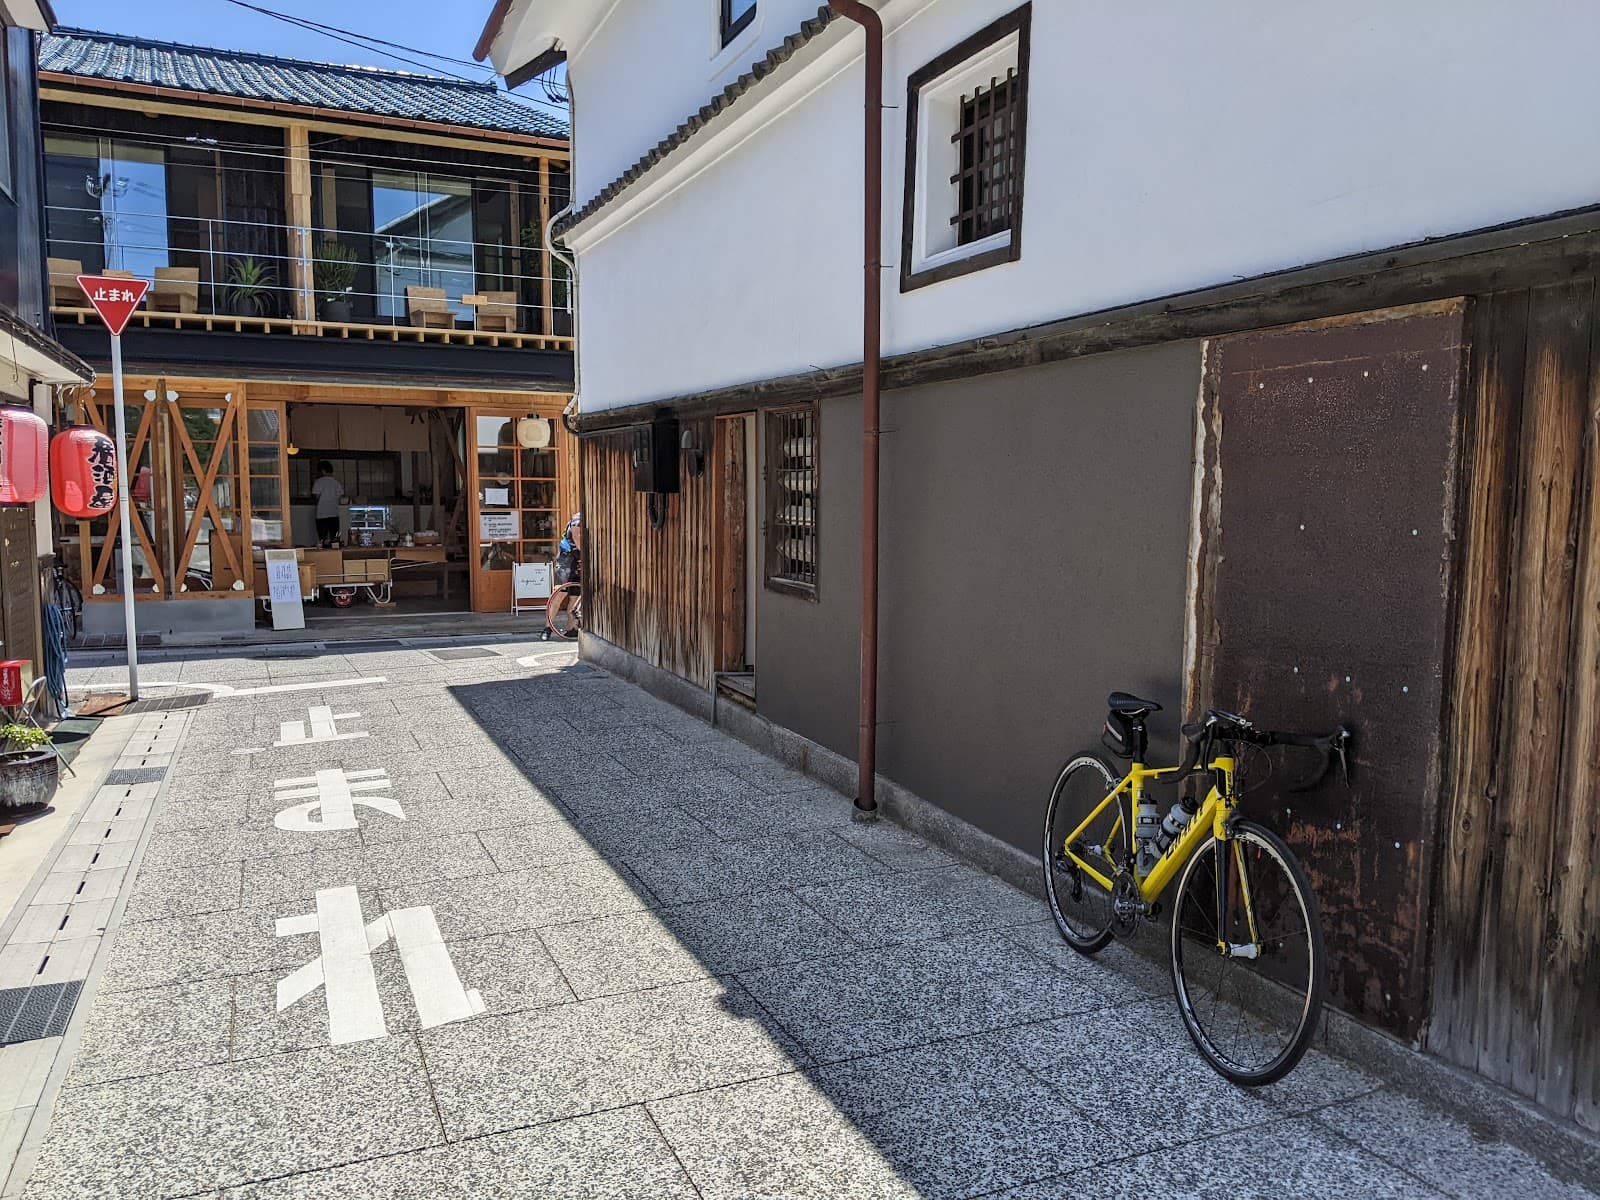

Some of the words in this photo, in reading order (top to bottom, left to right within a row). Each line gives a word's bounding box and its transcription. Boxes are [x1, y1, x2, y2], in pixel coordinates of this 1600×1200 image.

[93, 287, 136, 302] 止まれ
[273, 704, 487, 1046] 止まれ
